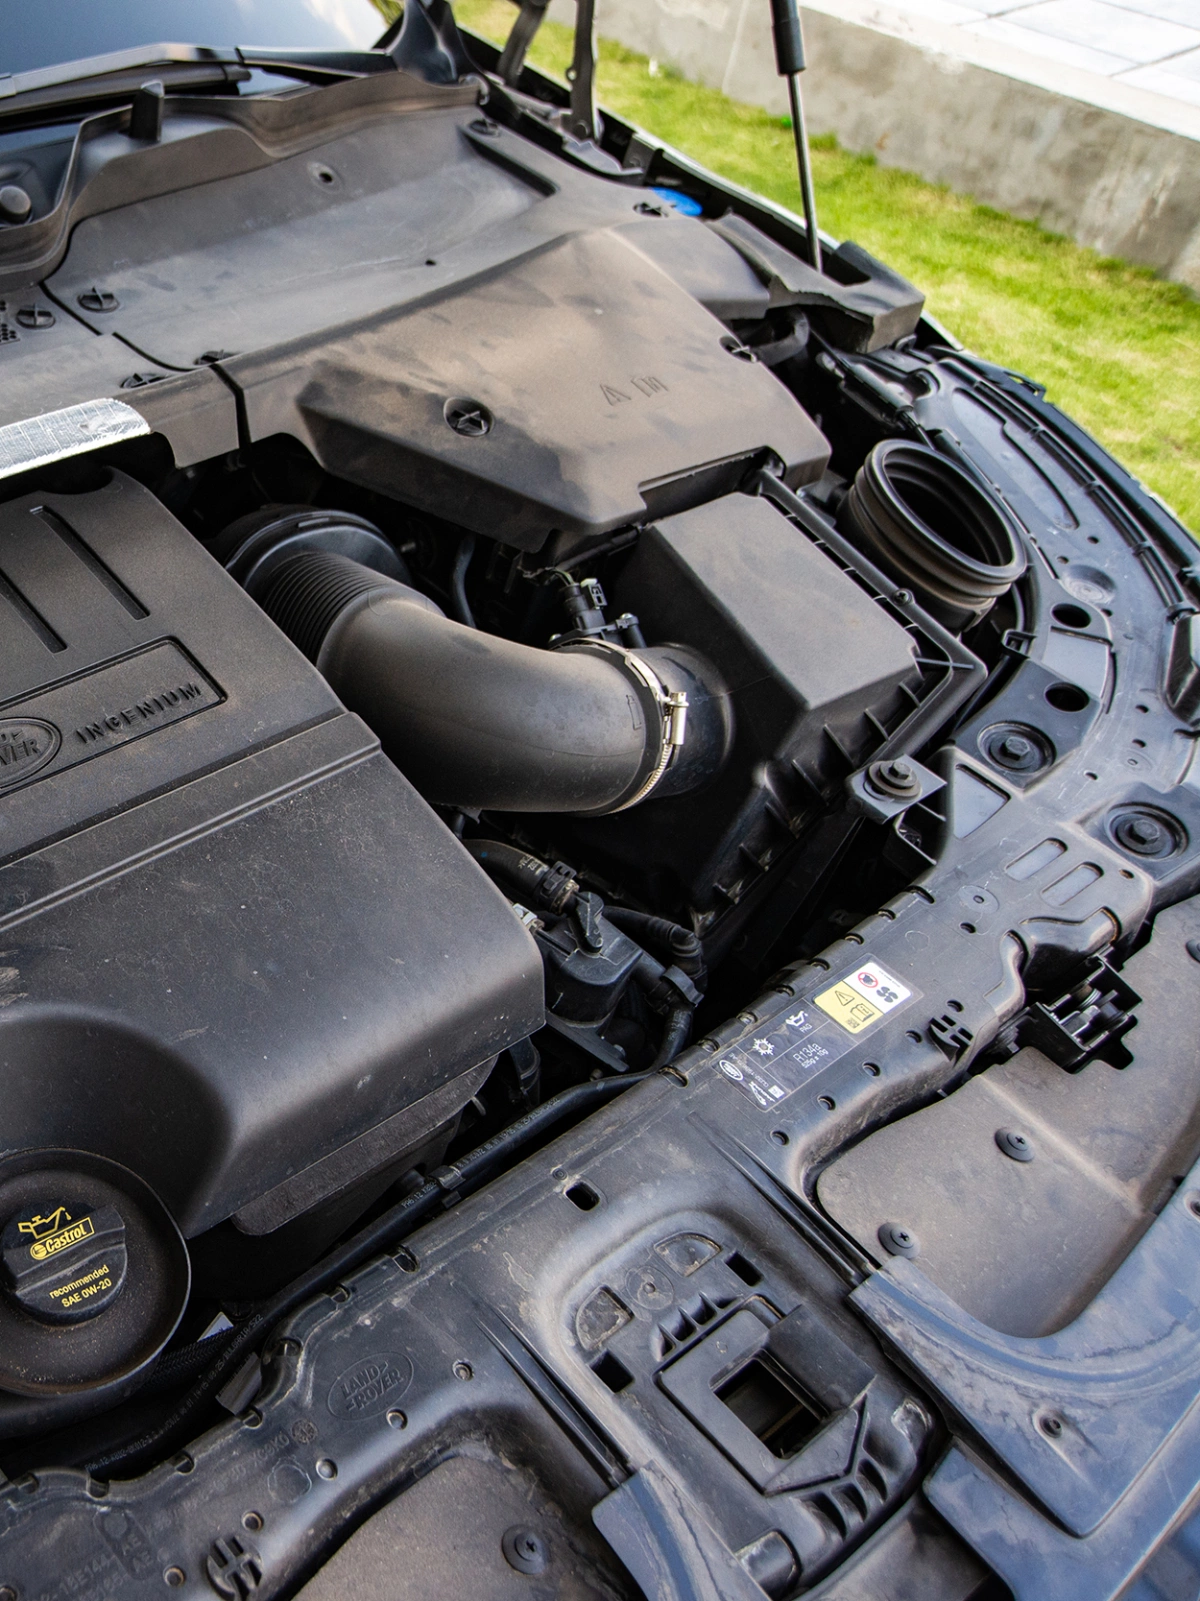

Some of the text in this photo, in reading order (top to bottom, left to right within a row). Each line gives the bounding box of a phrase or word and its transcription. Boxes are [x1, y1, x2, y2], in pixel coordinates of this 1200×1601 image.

[75, 681, 202, 745] INGENIUM
[792, 1042, 822, 1064] R134a
[45, 1223, 87, 1253] Castrol
[49, 1264, 110, 1299] recommended
[61, 1277, 113, 1308] SAE 0W-20
[340, 1364, 380, 1398] LAND
[354, 1367, 404, 1411] ROVER
